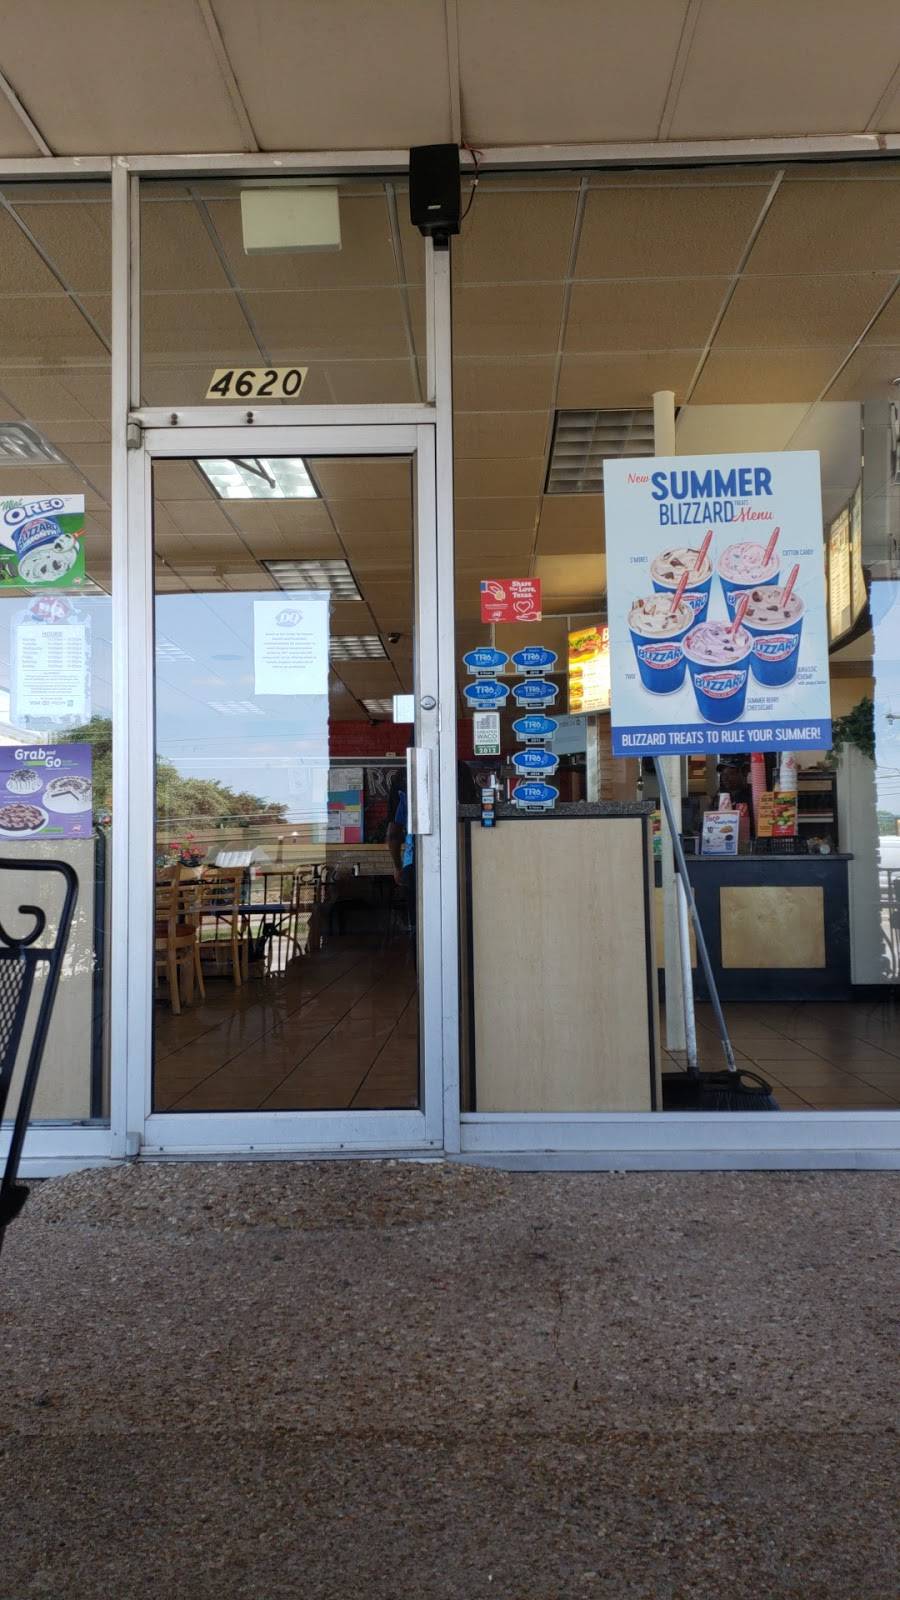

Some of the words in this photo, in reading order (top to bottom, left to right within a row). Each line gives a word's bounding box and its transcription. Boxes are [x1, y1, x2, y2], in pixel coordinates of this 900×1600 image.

[210, 369, 302, 397] 4620
[627, 473, 650, 485] New
[651, 467, 773, 501] SUMMER
[4, 498, 65, 526] OREO
[659, 501, 734, 526] BLIZZARD
[731, 506, 774, 523] Menu
[638, 649, 683, 662] BLIZZAR
[695, 673, 747, 690] BLIZZARD
[621, 733, 666, 747] BLIZZARD
[668, 731, 704, 745] TREATS
[706, 730, 719, 743] TO
[721, 730, 745, 743] RULE
[747, 728, 772, 742] YOUR
[775, 726, 821, 741] SUMMER!
[15, 748, 46, 760] Grab
[45, 756, 62, 768] Go
